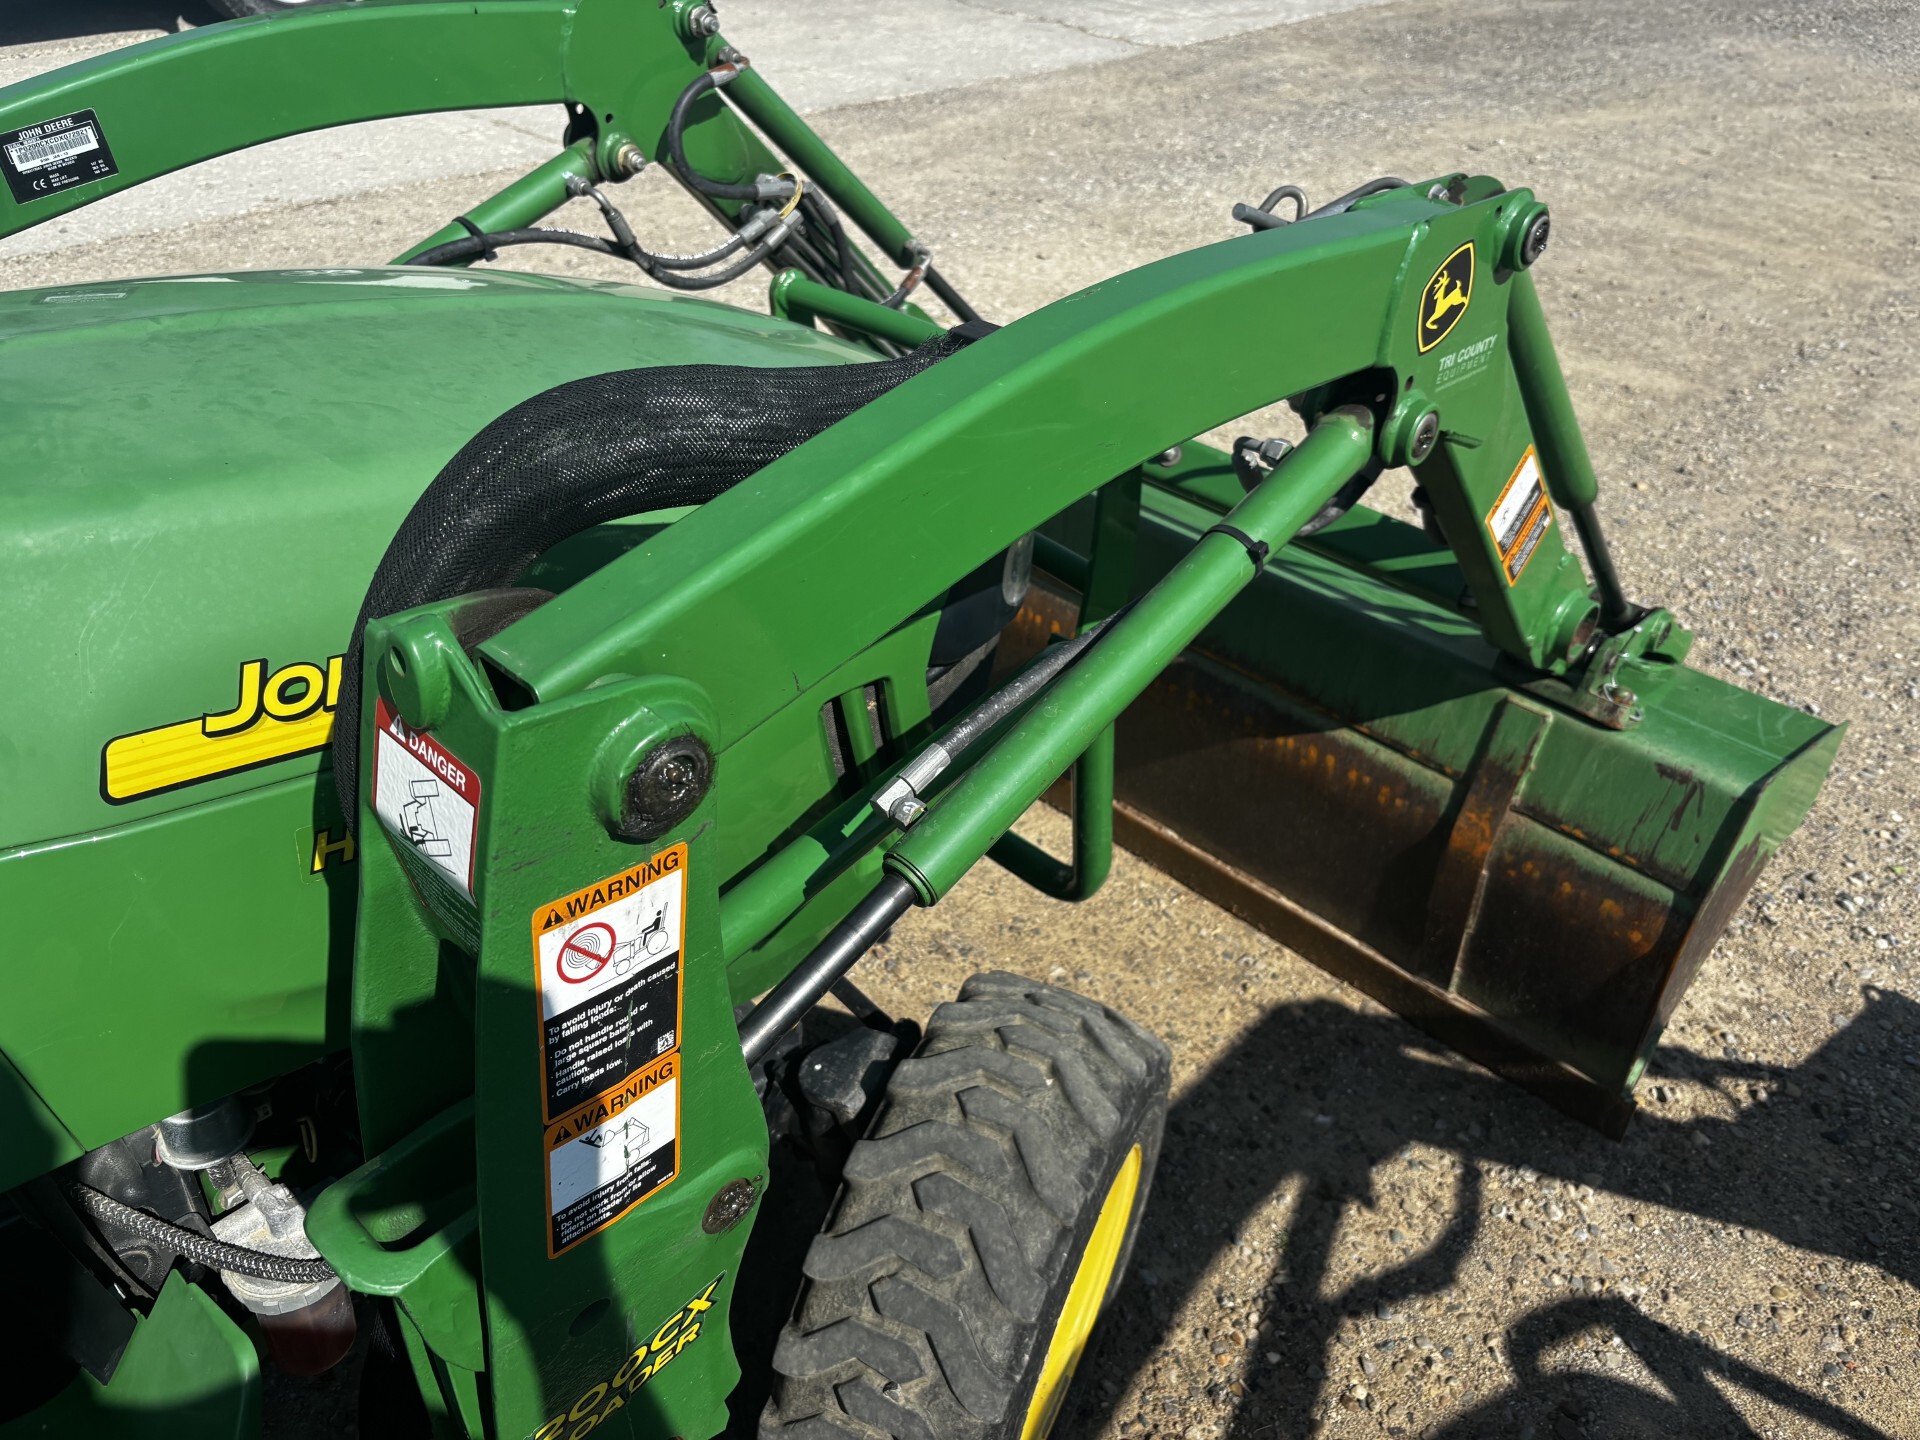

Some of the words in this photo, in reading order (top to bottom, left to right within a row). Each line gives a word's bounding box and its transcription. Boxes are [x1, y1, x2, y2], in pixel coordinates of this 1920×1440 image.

[18, 126, 42, 141] JOHN
[44, 117, 75, 133] DEERE
[1436, 350, 1493, 385] EQUIPMENT
[1439, 352, 1456, 372] TRI
[1457, 333, 1498, 363] COUNTY
[203, 655, 345, 736] JO
[409, 731, 466, 792] DANGER
[310, 823, 357, 876] H
[566, 851, 679, 918] WARNING
[548, 1027, 560, 1036] To
[562, 1012, 585, 1029] avoid
[588, 999, 612, 1017] injury
[614, 994, 624, 1002] or
[625, 979, 645, 997] death
[647, 962, 676, 982] caused
[548, 1035, 560, 1045] by
[562, 1020, 588, 1038] falling
[554, 1049, 567, 1058] Do
[568, 1039, 583, 1053] not
[585, 1024, 613, 1042] handle
[639, 1002, 648, 1010] or
[555, 1059, 585, 1078] Handle
[587, 1043, 613, 1062] raised
[637, 1018, 653, 1032] with
[555, 1050, 576, 1067] large
[578, 1036, 607, 1055] square
[556, 1066, 590, 1086] caution.
[556, 1080, 579, 1097] Carry
[581, 1067, 604, 1083] loads
[606, 1059, 623, 1070] low.
[573, 1062, 673, 1131] WARNING
[556, 1213, 566, 1222] To
[568, 1199, 590, 1216] avoid
[592, 1185, 615, 1201] injury
[616, 1172, 633, 1187] from
[634, 1158, 652, 1173] falls:
[561, 1220, 572, 1230] Do
[574, 1211, 588, 1223] not
[589, 1198, 609, 1214] work
[610, 1186, 627, 1200] from
[628, 1178, 637, 1187] or
[637, 1164, 657, 1181] allow
[561, 1219, 585, 1237] riders
[586, 1212, 597, 1222] on
[599, 1196, 623, 1215] loader
[623, 1189, 632, 1198] or
[561, 1211, 613, 1244] attachments.
[535, 1281, 718, 1440] 200CX
[569, 1322, 701, 1440] OADER
